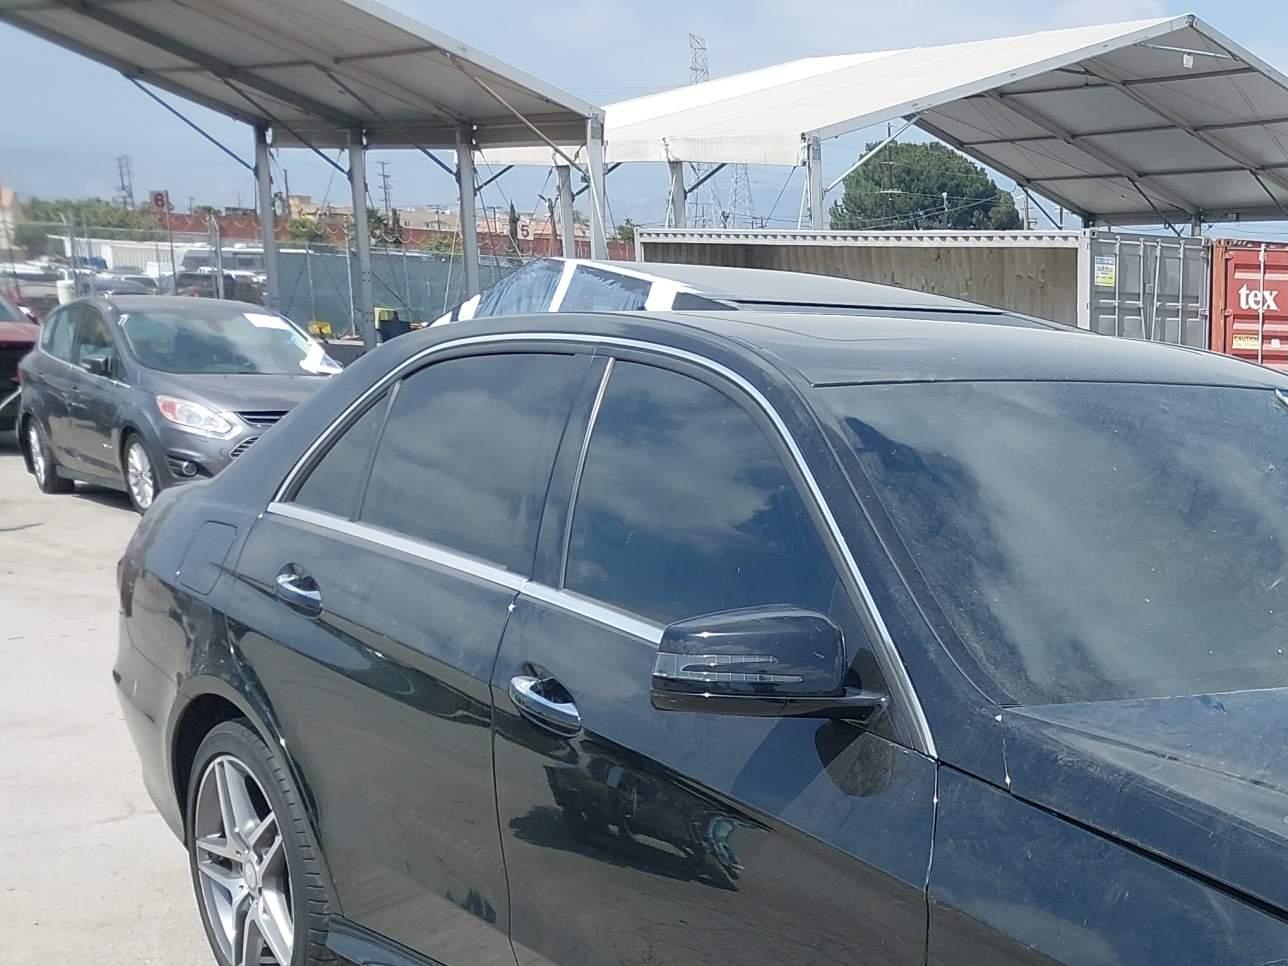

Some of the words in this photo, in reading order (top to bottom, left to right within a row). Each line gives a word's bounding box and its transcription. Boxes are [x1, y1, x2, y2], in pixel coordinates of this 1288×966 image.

[154, 193, 165, 208] 6
[521, 224, 530, 238] 5
[1238, 282, 1280, 312] tex
